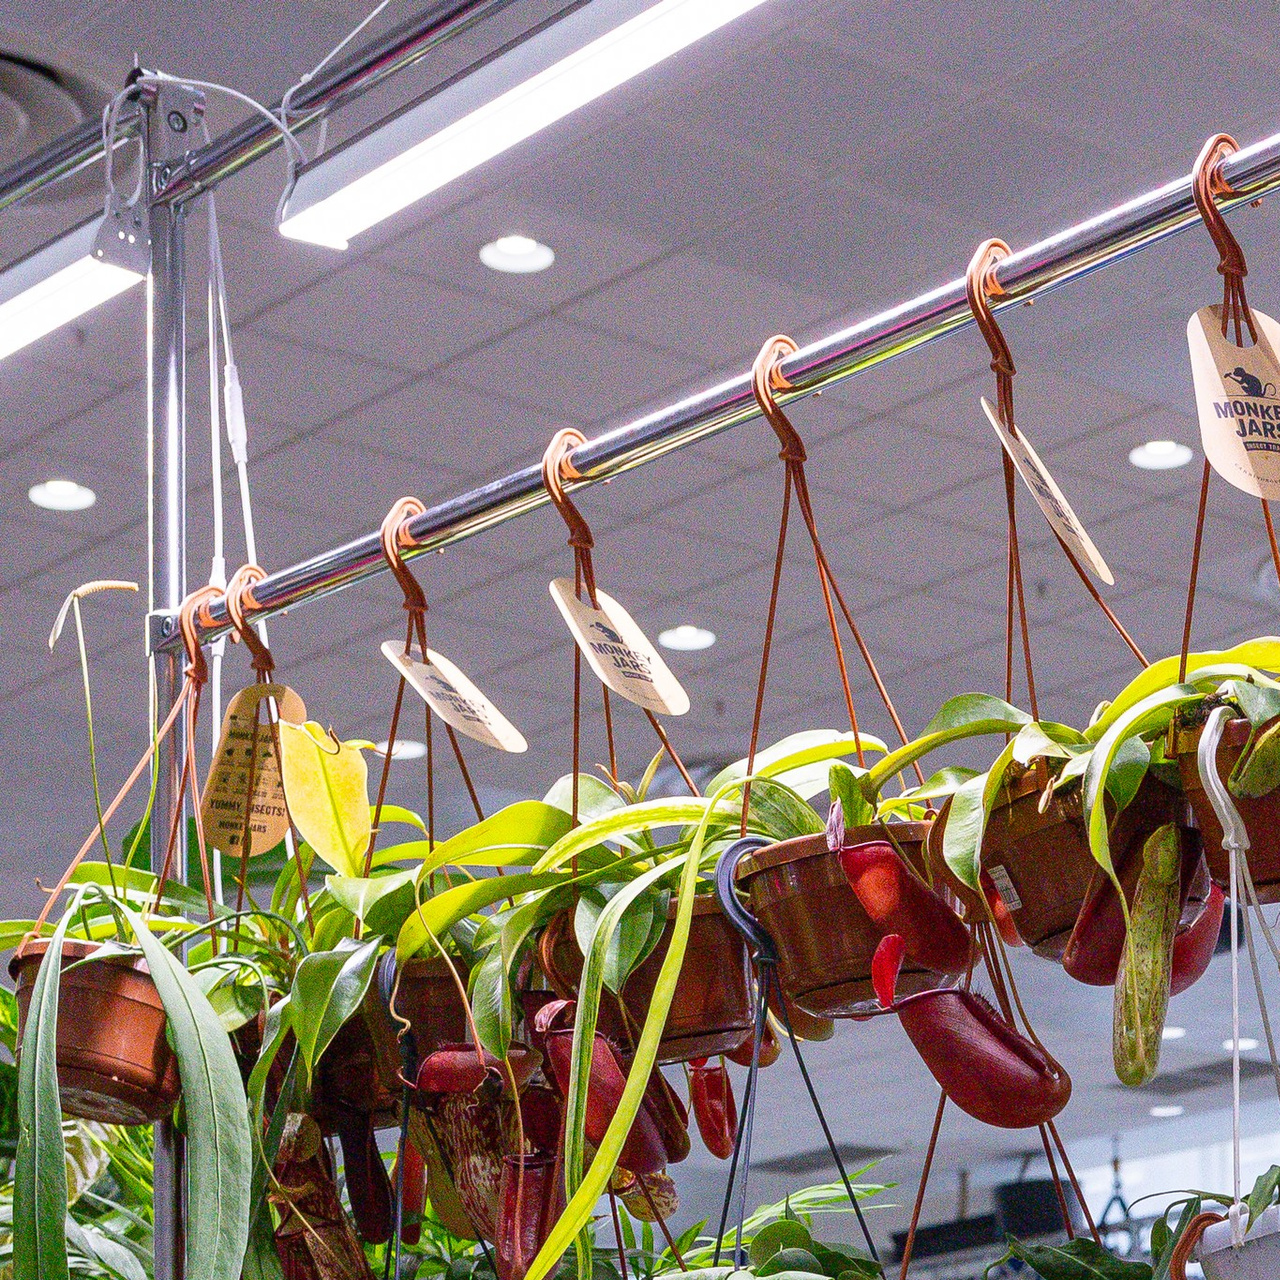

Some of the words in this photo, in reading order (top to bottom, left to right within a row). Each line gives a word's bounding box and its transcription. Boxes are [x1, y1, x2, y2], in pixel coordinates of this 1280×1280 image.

[590, 642, 652, 664] MONKEY
[612, 655, 652, 675] JARS
[250, 803, 286, 818] SECTS!
